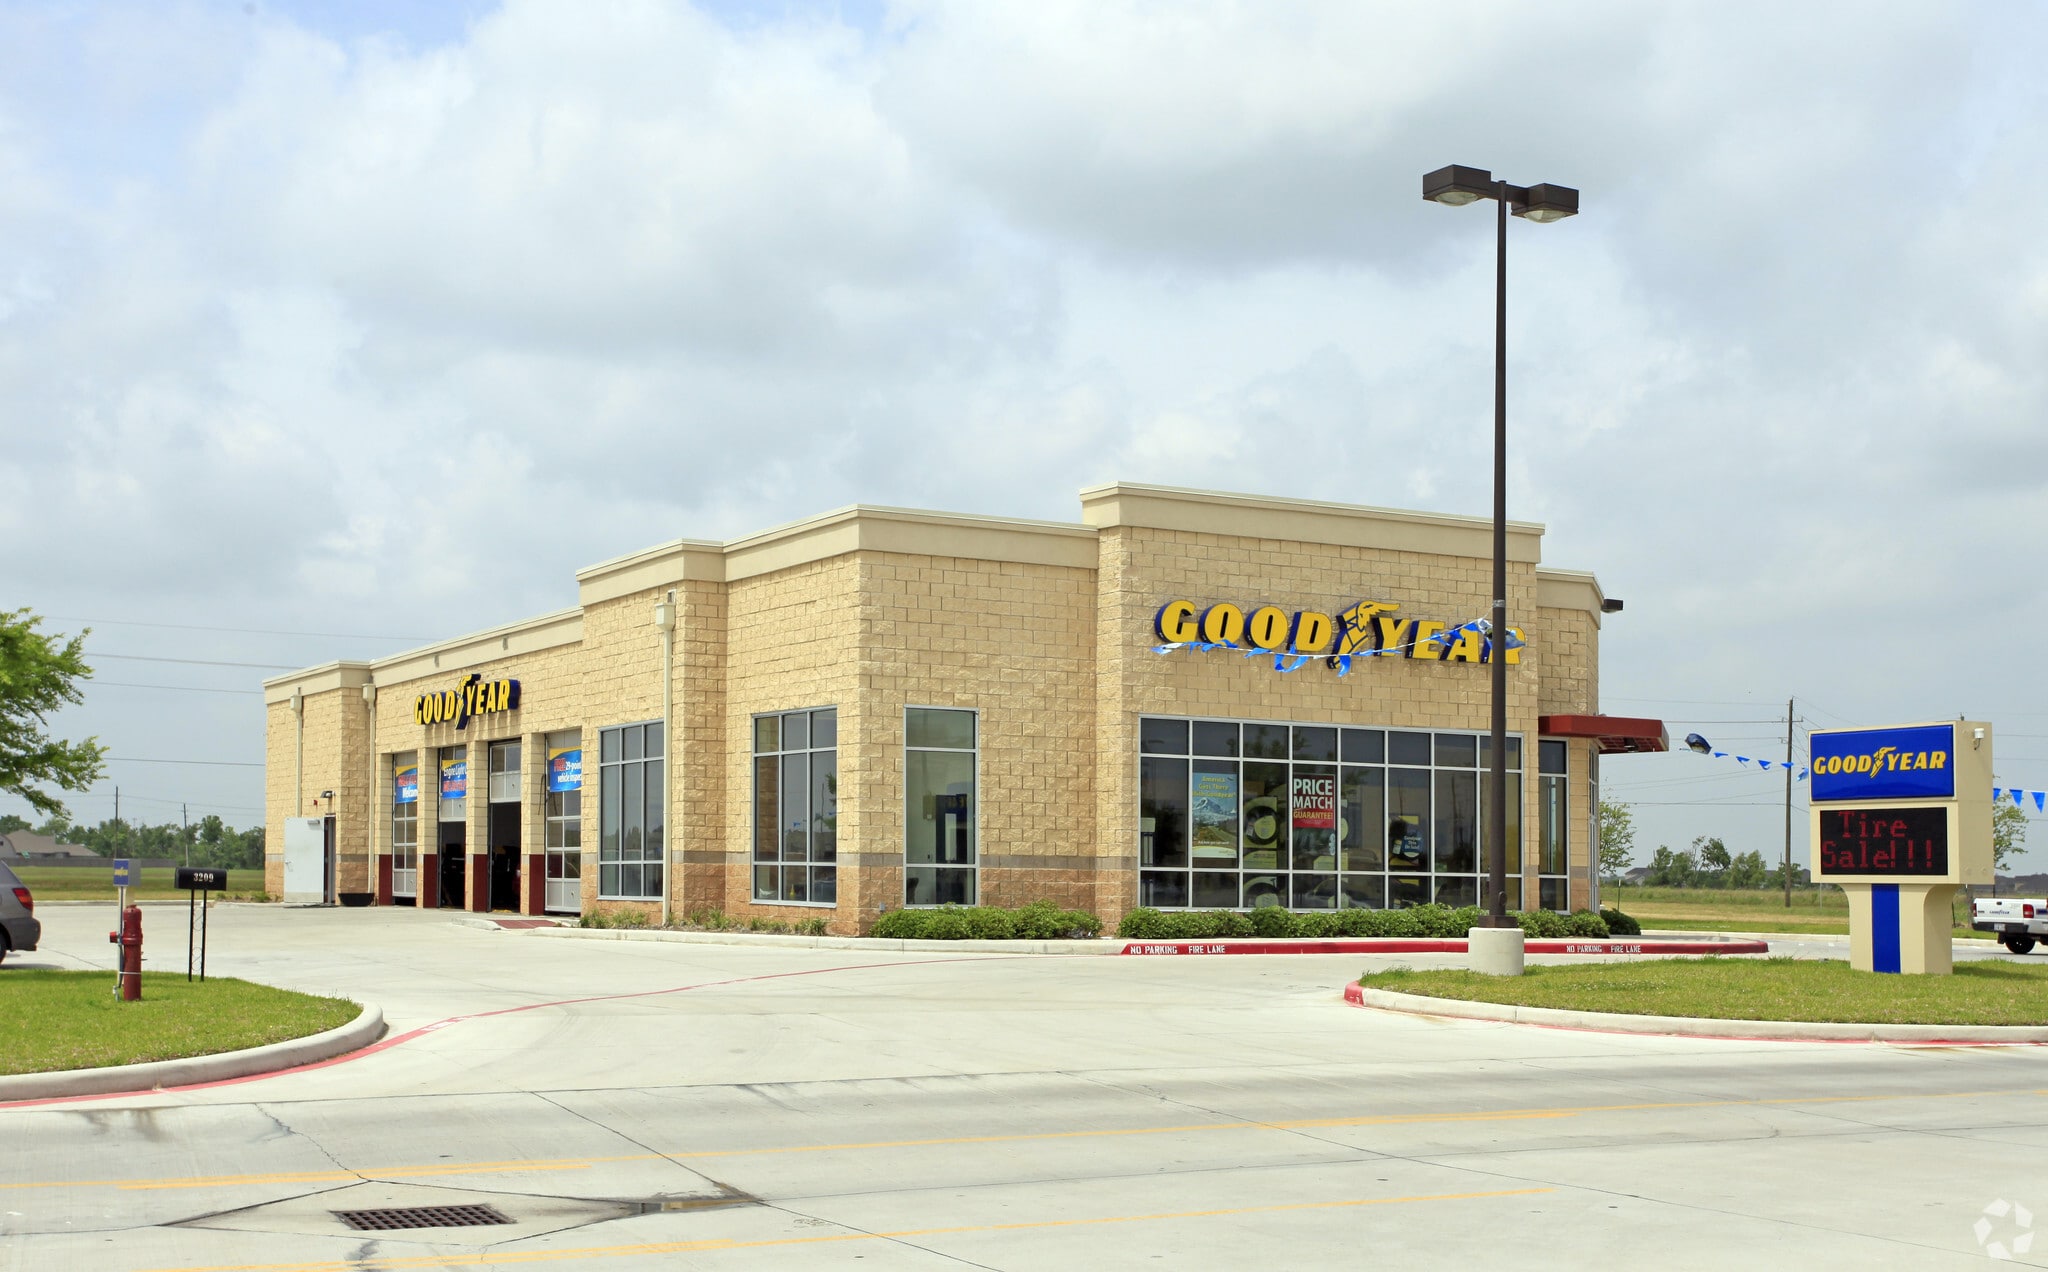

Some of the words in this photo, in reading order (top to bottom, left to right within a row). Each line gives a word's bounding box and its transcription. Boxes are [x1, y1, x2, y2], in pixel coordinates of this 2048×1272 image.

[1293, 778, 1333, 796] PRICE
[1293, 795, 1333, 809] MATCH
[1838, 810, 1908, 838] Tire
[1822, 839, 1932, 868] Sale!!!
[193, 872, 214, 882] 3209
[1130, 946, 1142, 954] NO
[1144, 945, 1178, 954] PARKING
[1188, 945, 1204, 954] FIRE
[1207, 945, 1226, 954] LANE
[1566, 945, 1575, 953] NO
[1577, 944, 1603, 953] PARKING
[1610, 944, 1624, 953] FIRE
[1626, 944, 1642, 953] LANE
